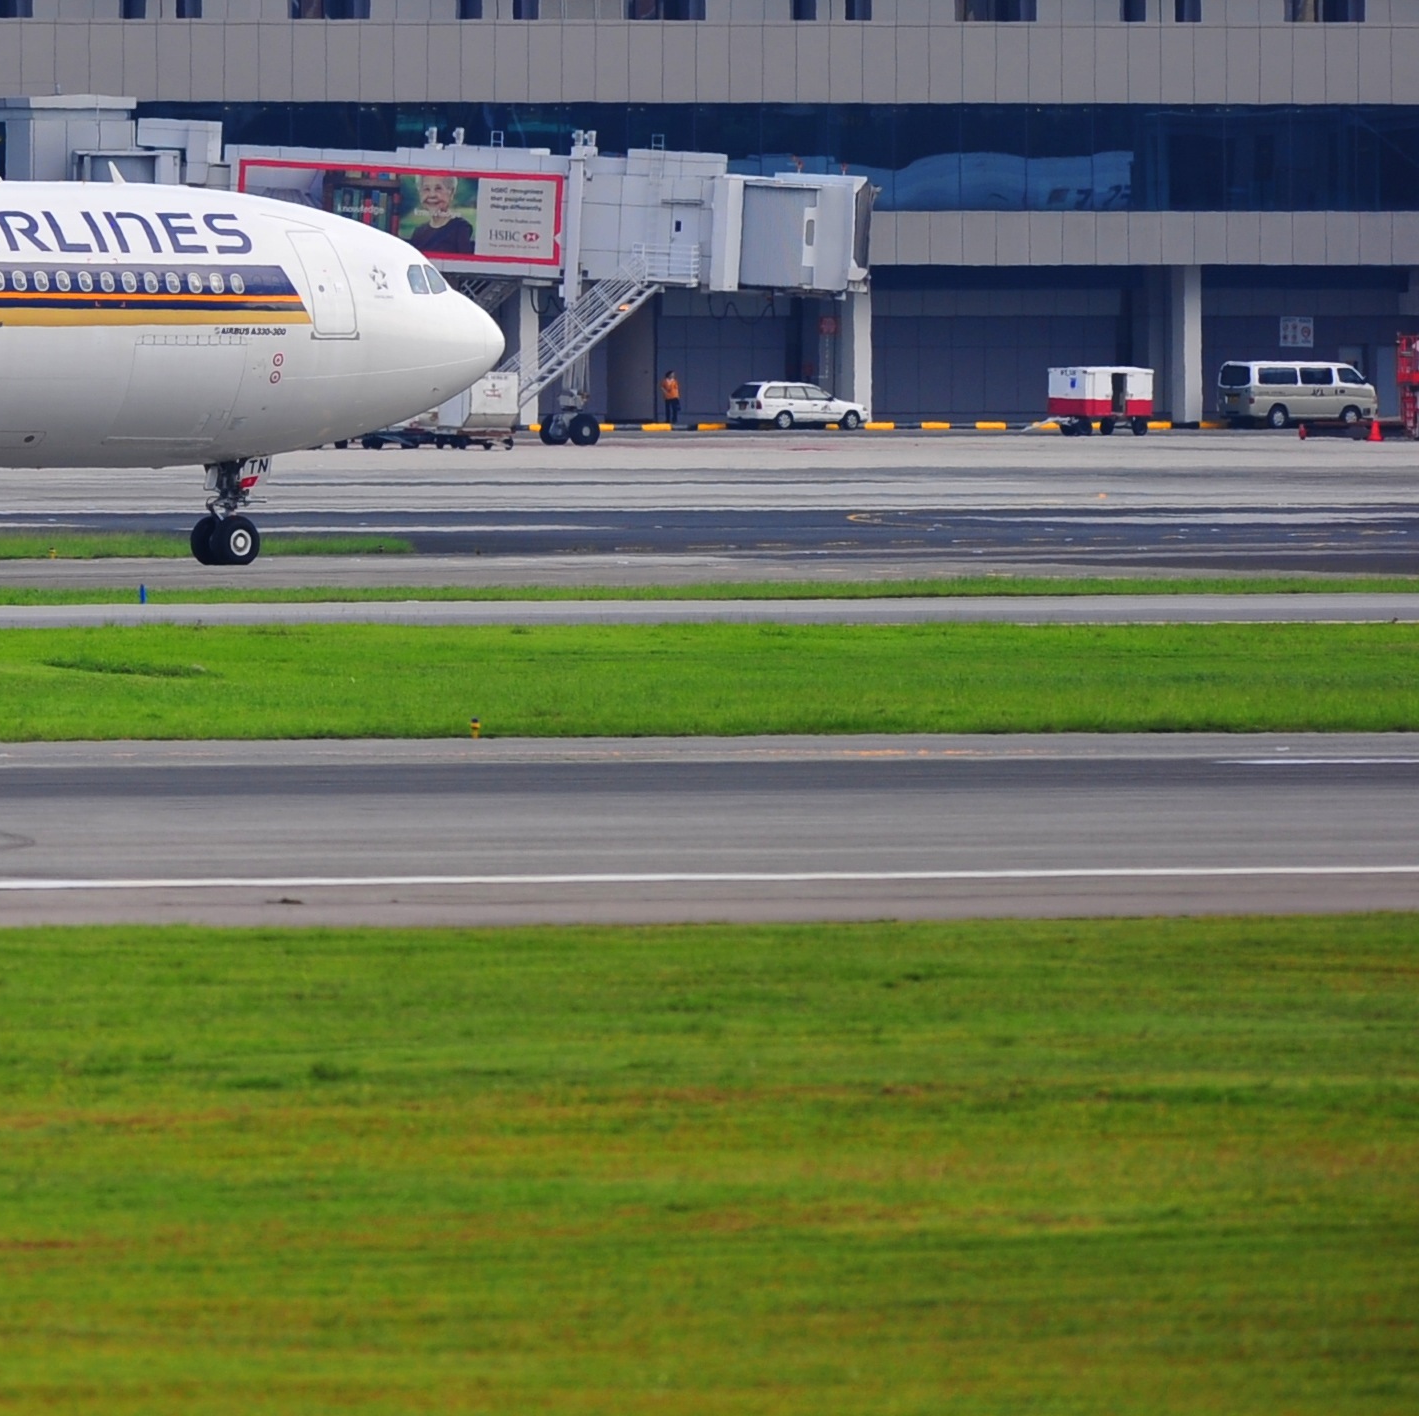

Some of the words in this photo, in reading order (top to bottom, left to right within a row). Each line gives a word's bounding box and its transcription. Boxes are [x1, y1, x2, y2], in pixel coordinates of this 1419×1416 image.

[337, 204, 385, 215] knowledge
[489, 229, 520, 242] HSBC
[221, 327, 250, 336] AIRBUS
